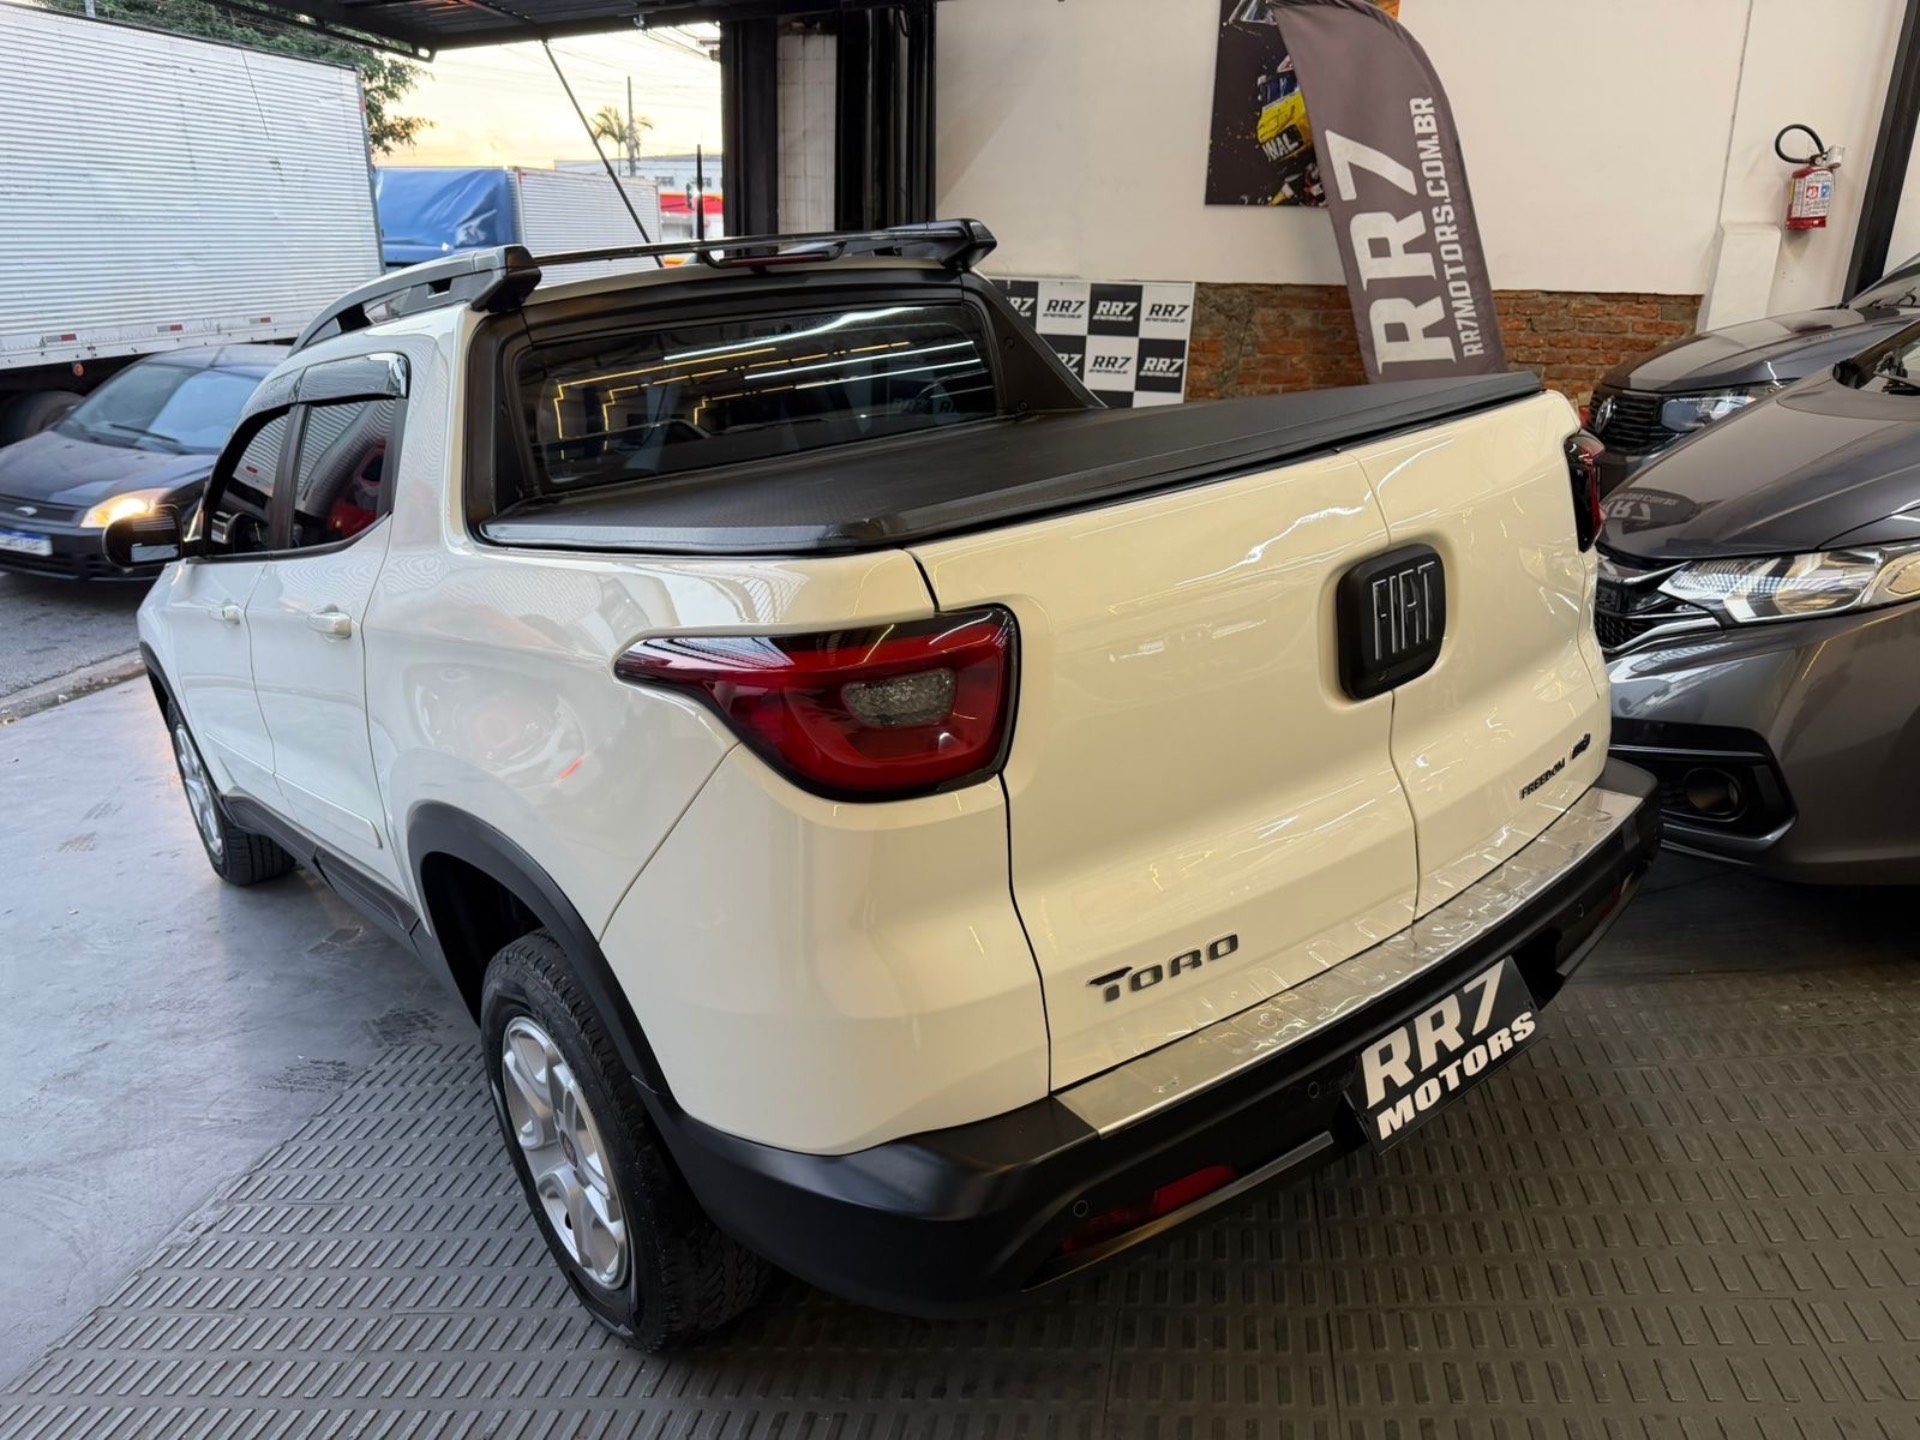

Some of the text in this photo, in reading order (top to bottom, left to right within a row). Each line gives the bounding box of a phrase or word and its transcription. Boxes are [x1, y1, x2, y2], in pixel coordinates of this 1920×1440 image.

[1410, 97, 1484, 357] RR7MOTORS.COM.BR
[1325, 129, 1457, 375] RR7
[1006, 296, 1036, 311] R7
[1046, 299, 1087, 313] RR7
[1096, 300, 1138, 316] RR7
[1149, 303, 1190, 317] RR7
[1056, 353, 1083, 367] R7
[1092, 355, 1132, 369] RR7
[1143, 357, 1185, 372] RR7
[1373, 561, 1435, 660] FIAT
[1520, 757, 1565, 799] FREEDOM
[1088, 933, 1239, 1003] TORO
[1361, 958, 1505, 1109] RR7
[1376, 1011, 1536, 1140] MOTORS
